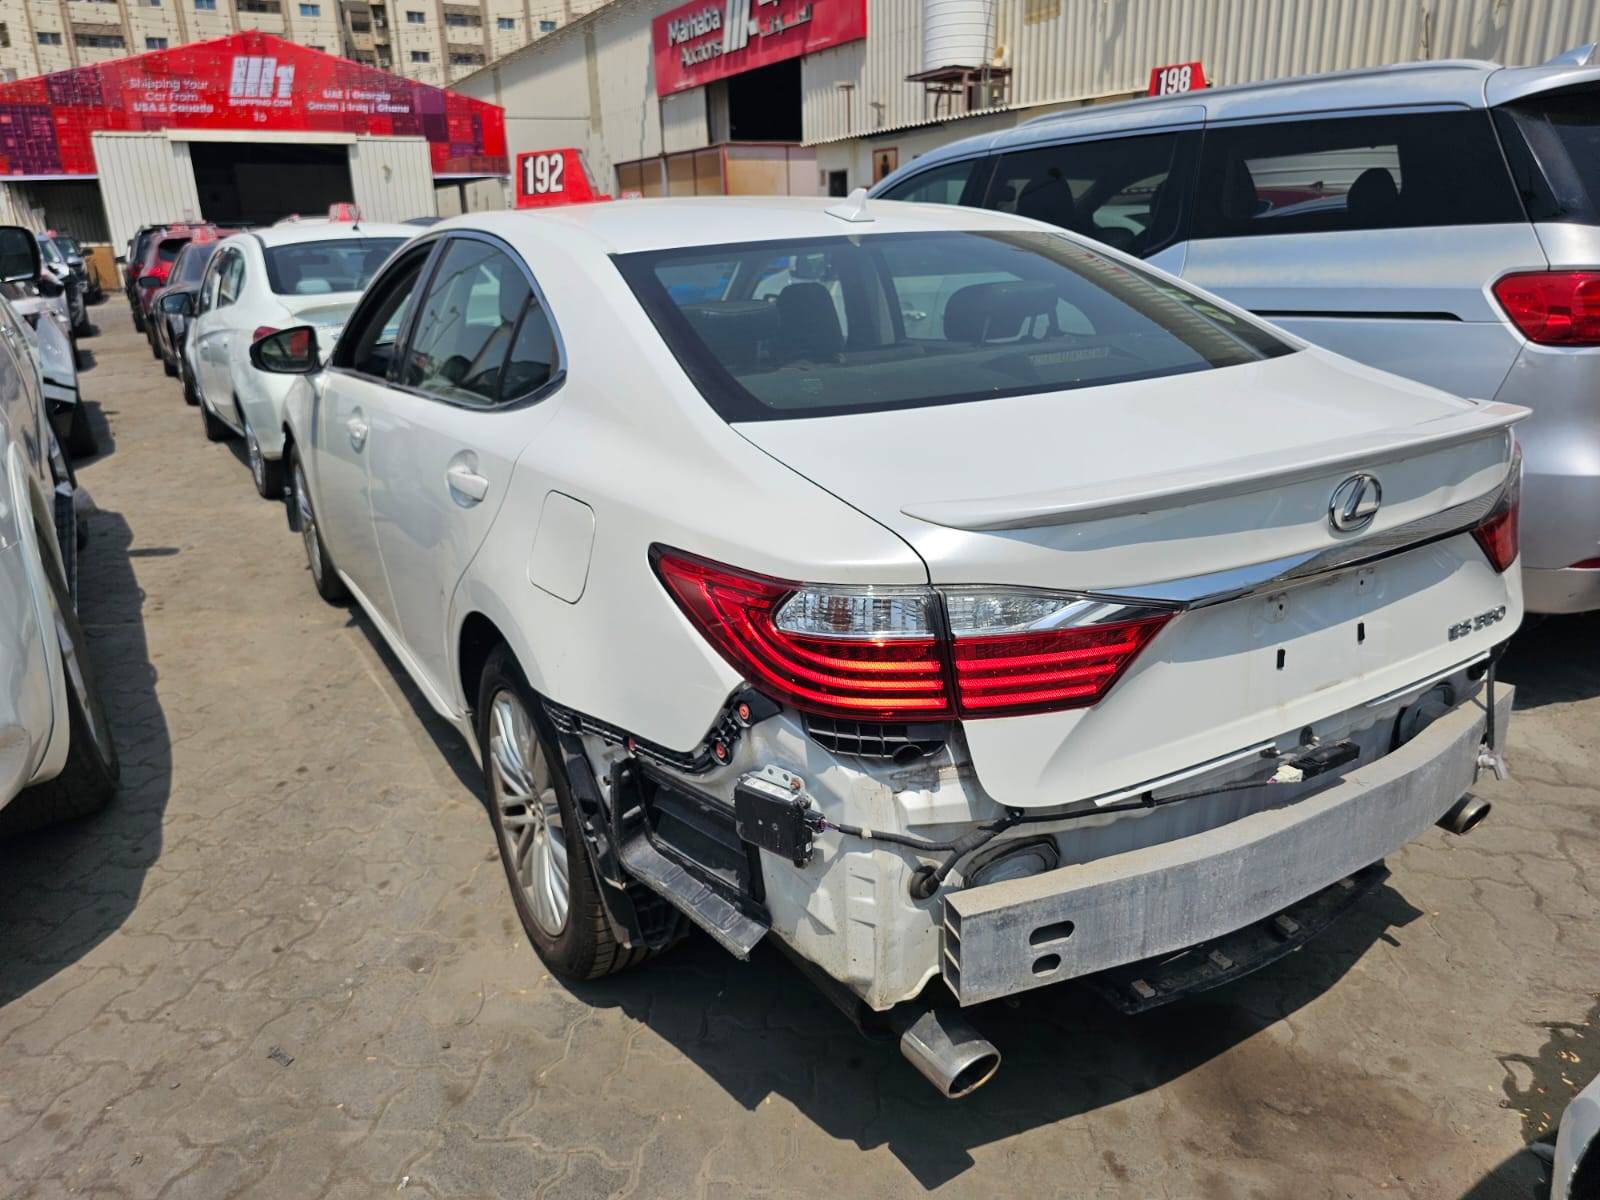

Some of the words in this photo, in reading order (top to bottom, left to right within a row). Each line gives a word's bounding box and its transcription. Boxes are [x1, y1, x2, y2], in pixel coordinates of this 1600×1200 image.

[668, 6, 721, 47] Marhaba
[681, 40, 723, 67] Auctions
[128, 78, 181, 91] Shipping
[182, 79, 209, 90] Your
[1160, 66, 1191, 96] 198
[145, 91, 167, 102] Car
[169, 92, 199, 102] From
[323, 88, 343, 99] UAE
[352, 89, 391, 102] Georgia
[133, 102, 157, 113] USA
[169, 102, 214, 113] Canada
[306, 101, 339, 111] Oman
[346, 102, 369, 114] Iraq
[377, 103, 410, 113] Ghana
[524, 153, 564, 195] 192
